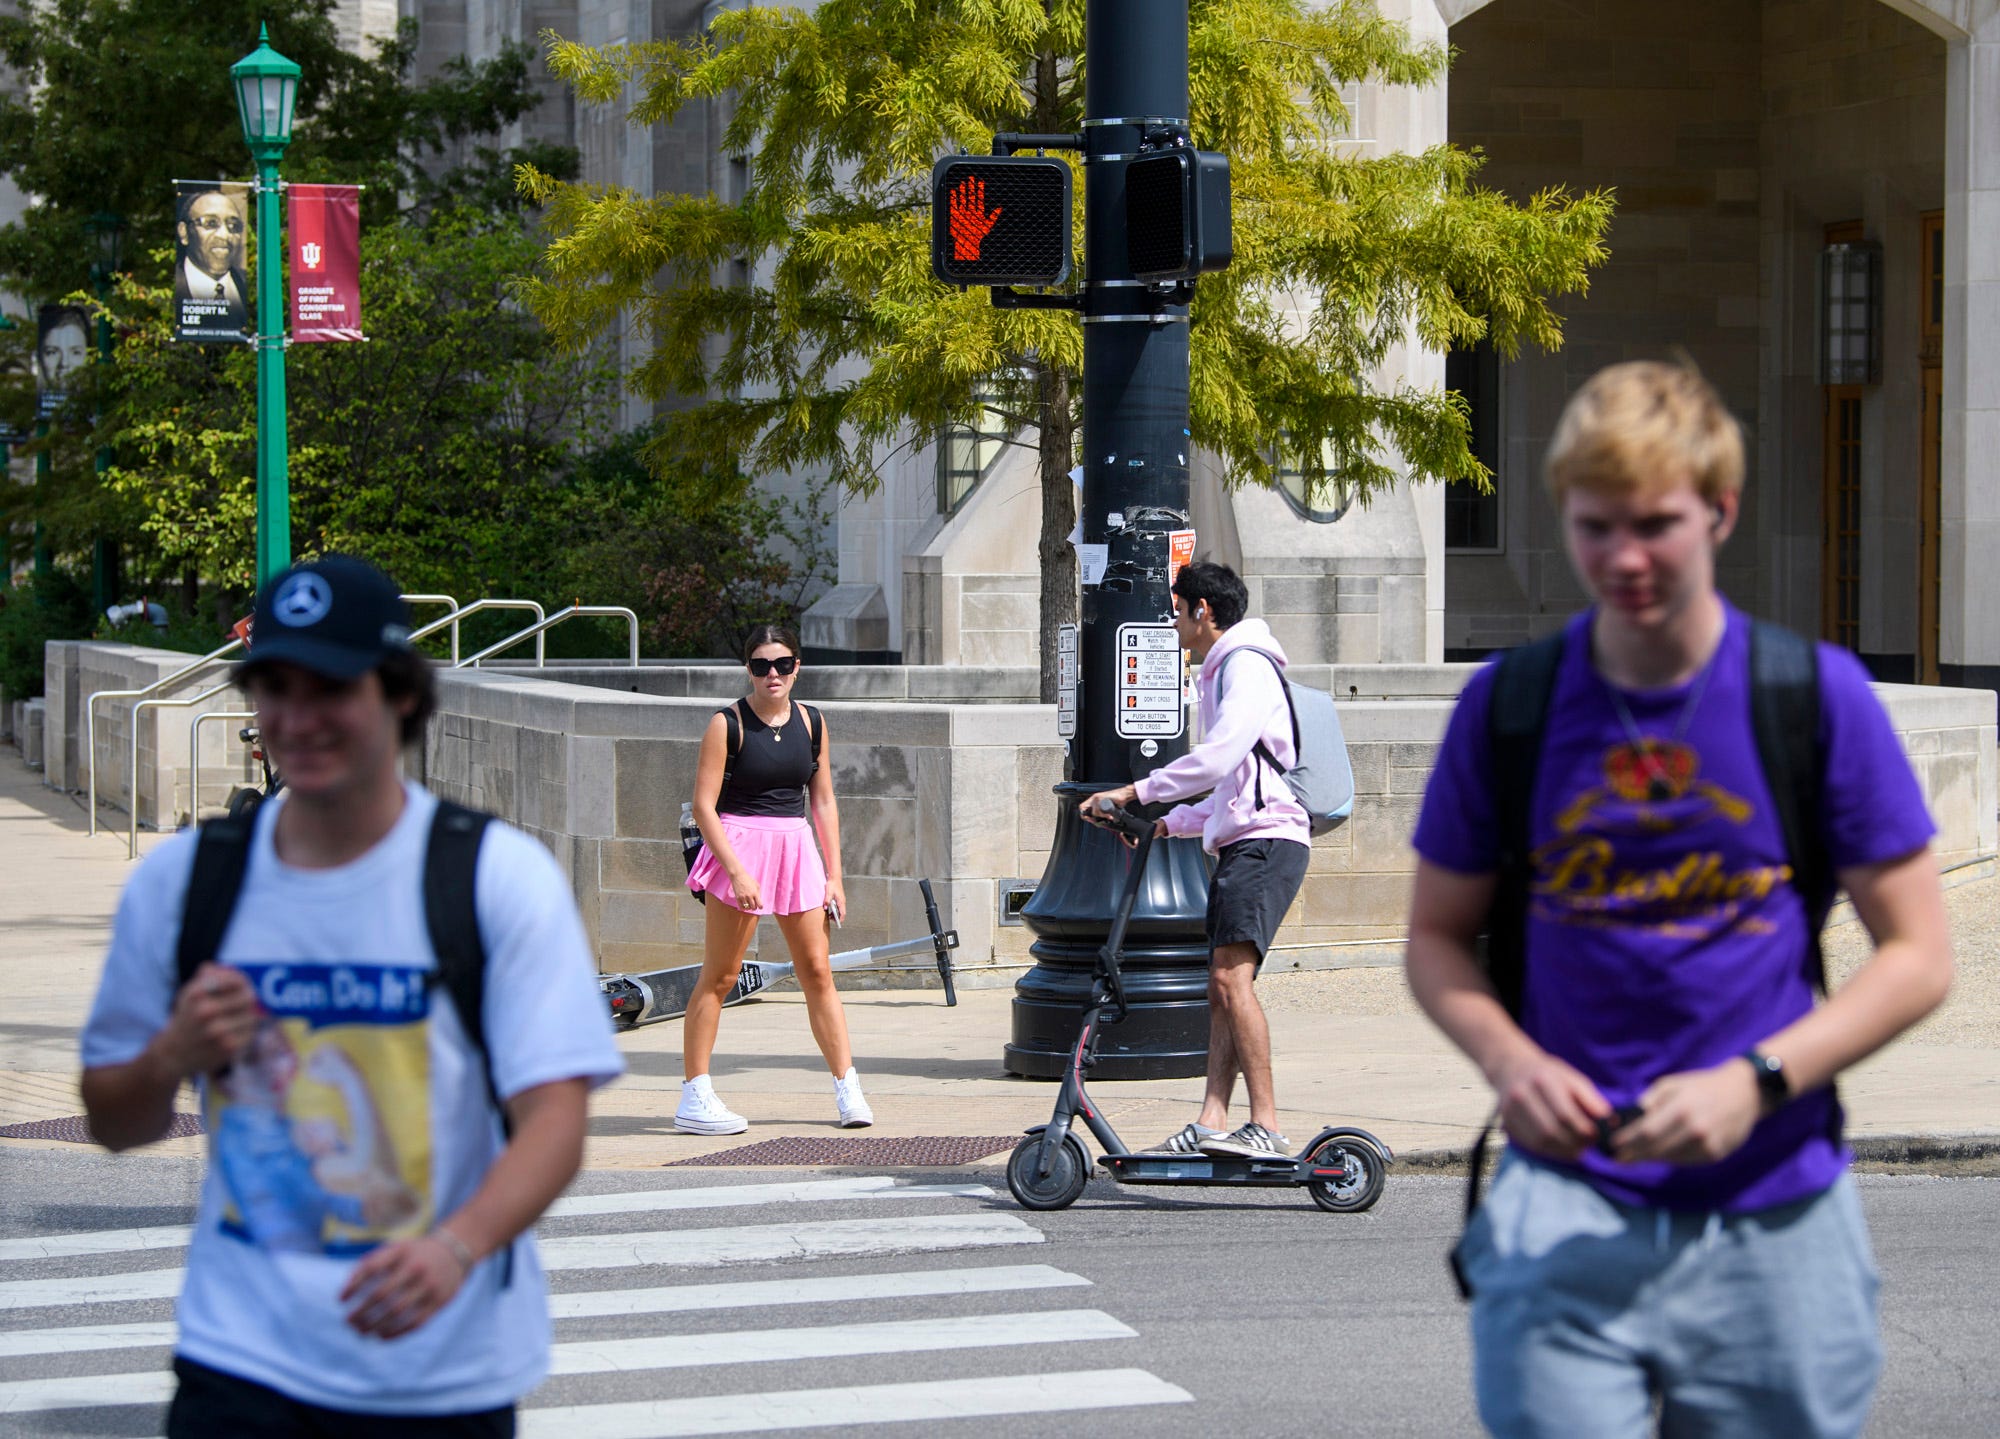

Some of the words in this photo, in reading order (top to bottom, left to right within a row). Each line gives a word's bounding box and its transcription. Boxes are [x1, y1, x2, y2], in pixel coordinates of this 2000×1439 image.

[298, 287, 334, 295] GRADUATE
[298, 295, 308, 304] OF
[308, 295, 328, 304] FIRST
[182, 305, 217, 315] ROBERT
[217, 306, 229, 316] M.
[182, 315, 201, 325] LEE
[299, 312, 322, 321] CLASS
[261, 966, 327, 1009] Can
[330, 968, 377, 1009] Do
